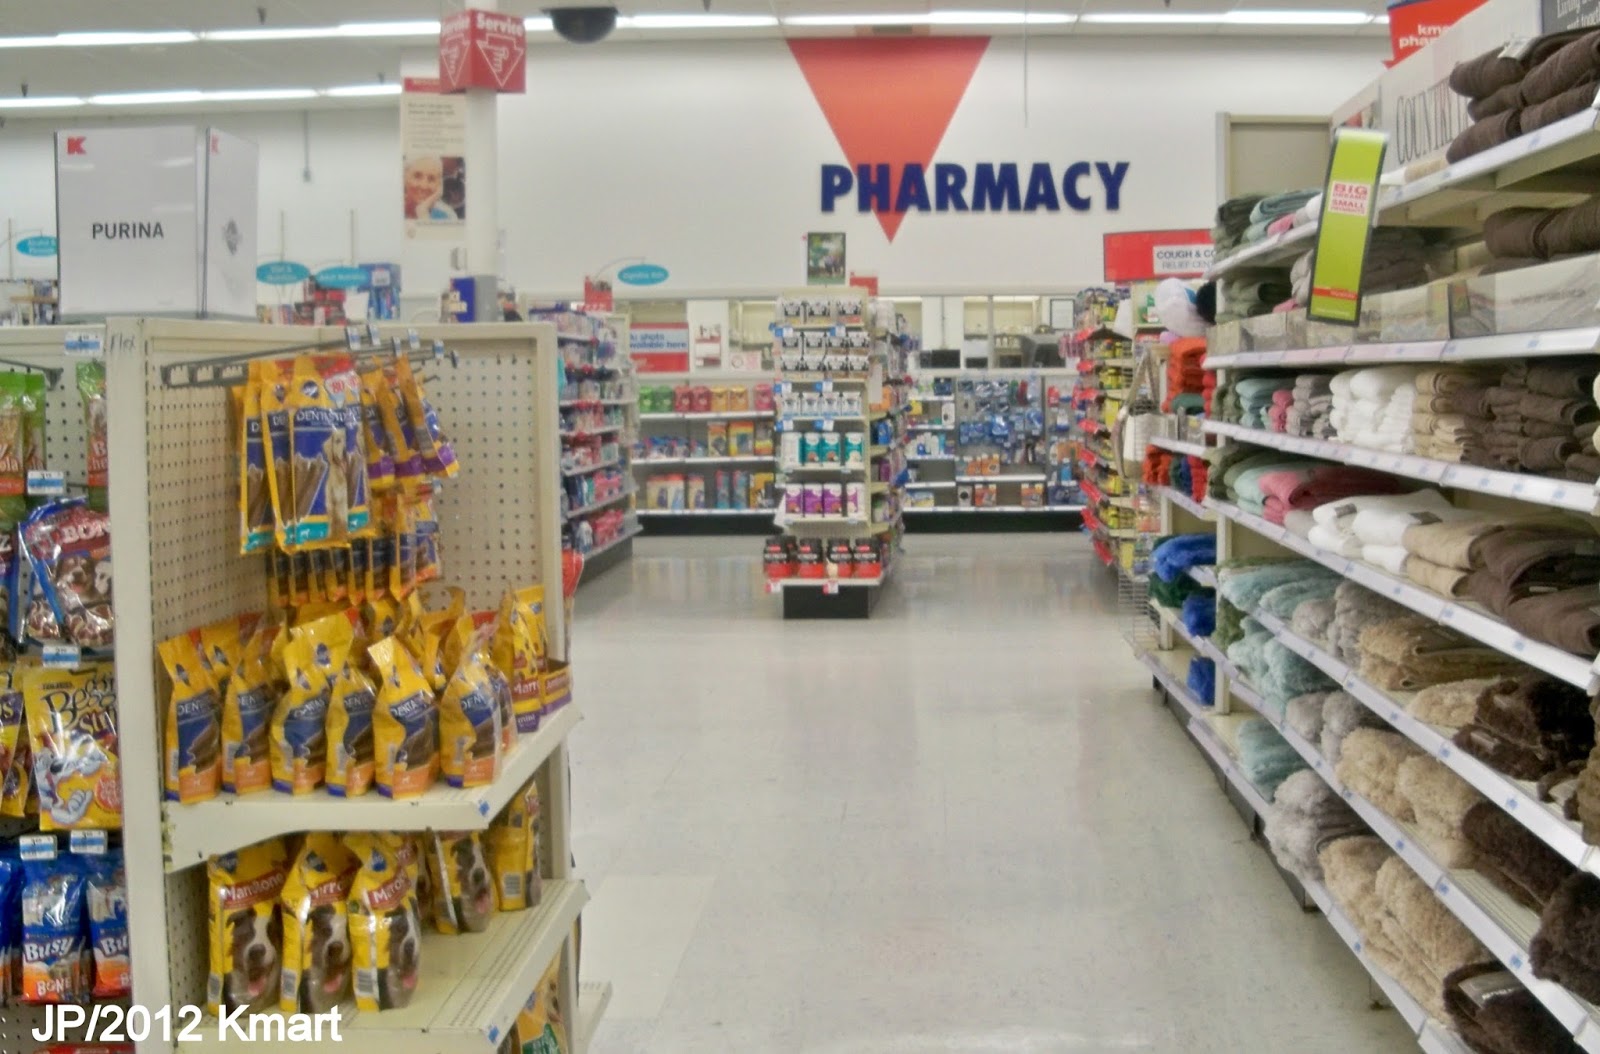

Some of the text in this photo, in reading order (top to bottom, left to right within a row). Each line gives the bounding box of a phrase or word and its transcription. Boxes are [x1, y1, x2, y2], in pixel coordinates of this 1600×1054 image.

[475, 12, 523, 36] Service
[821, 161, 1130, 213] PHARMACY
[1334, 183, 1368, 195] BIG
[92, 222, 164, 240] PURINA
[1156, 250, 1192, 259] COUGH
[24, 937, 75, 962] Busy
